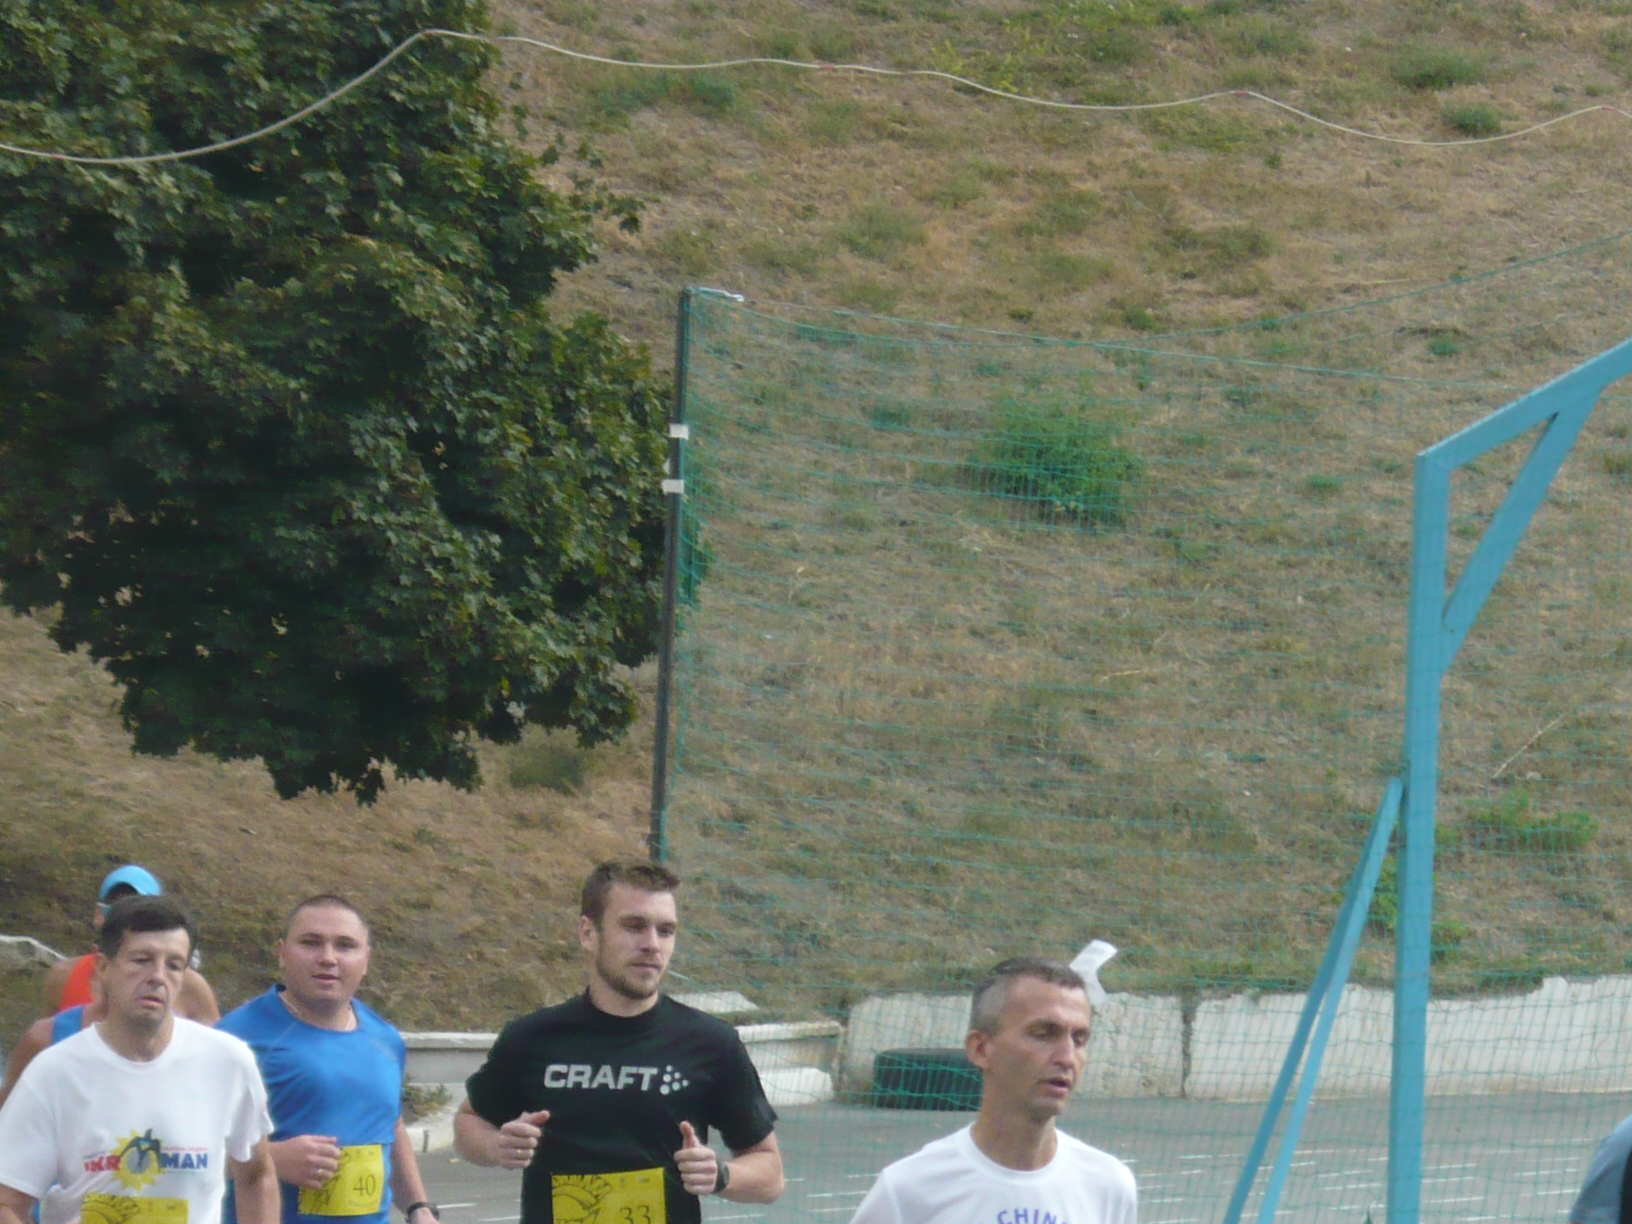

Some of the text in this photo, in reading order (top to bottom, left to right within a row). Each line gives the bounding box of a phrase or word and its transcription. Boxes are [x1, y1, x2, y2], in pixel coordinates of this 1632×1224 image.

[543, 1063, 658, 1092] CRAFT
[160, 1152, 209, 1169] MAN
[352, 1174, 377, 1198] 40
